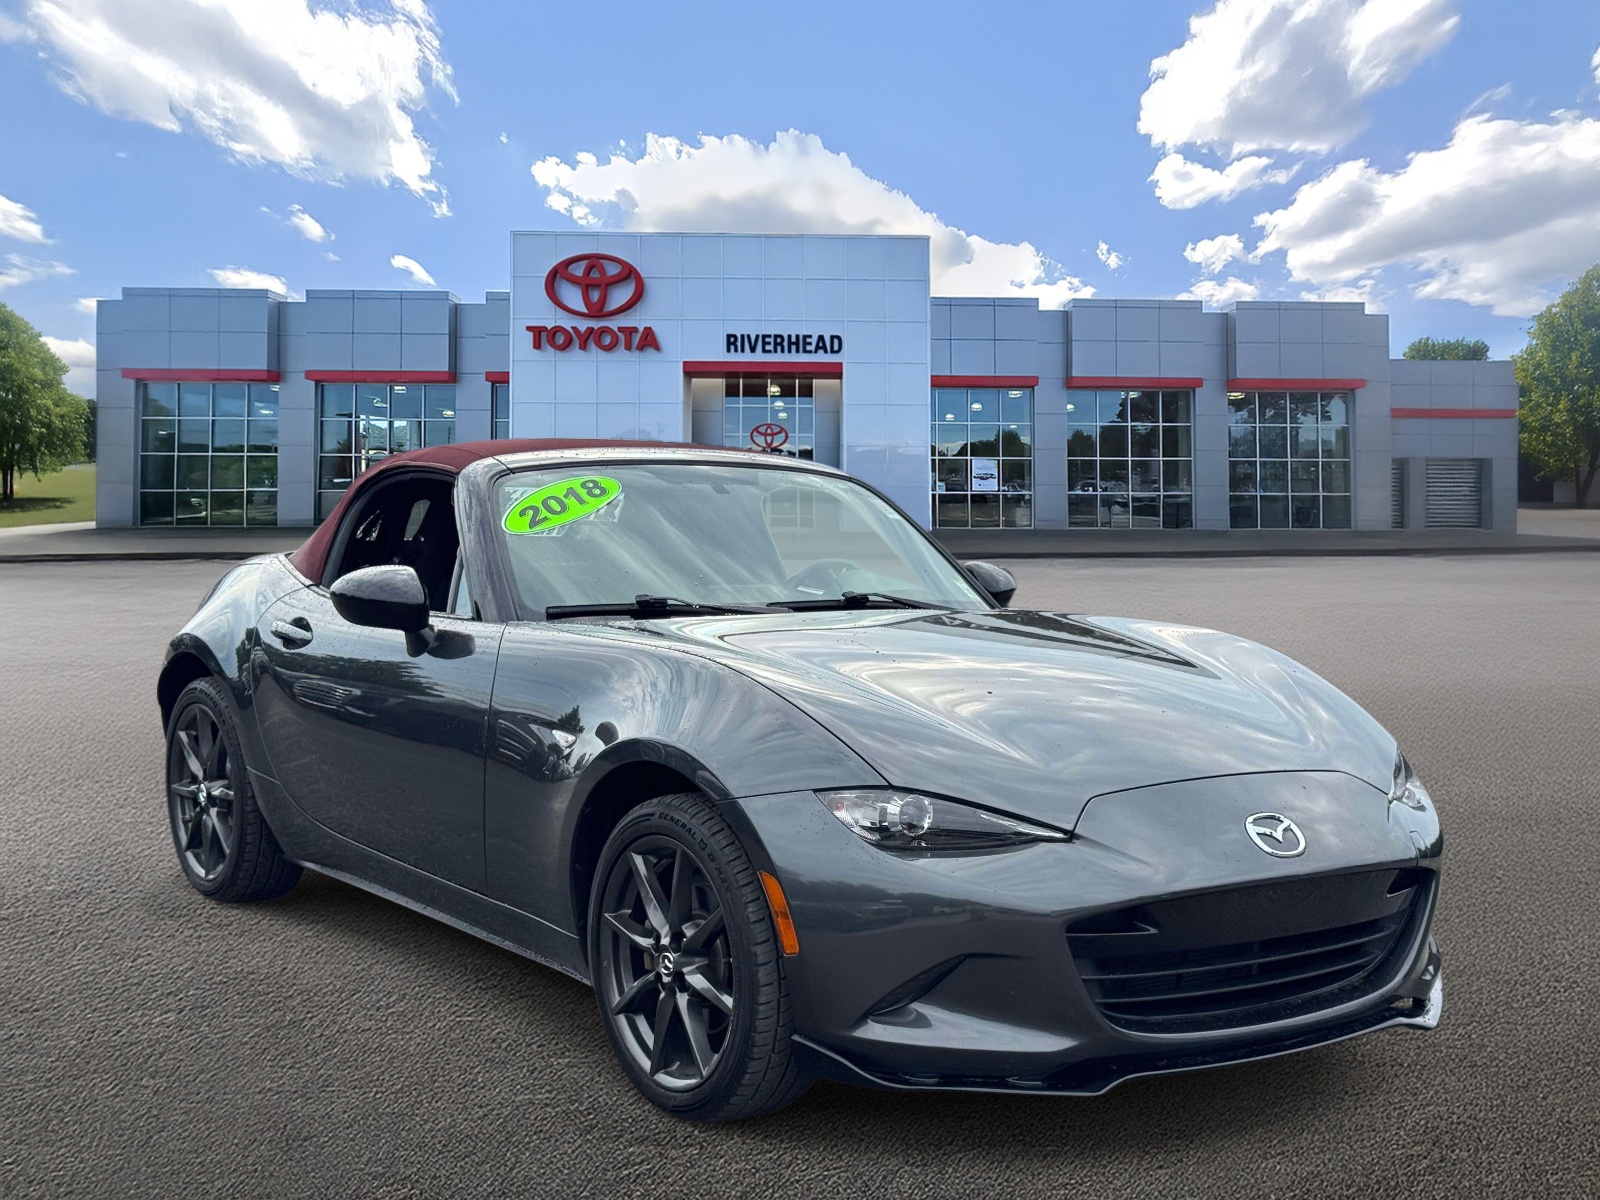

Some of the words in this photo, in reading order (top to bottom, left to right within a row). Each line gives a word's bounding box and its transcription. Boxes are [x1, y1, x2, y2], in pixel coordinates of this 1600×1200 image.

[525, 325, 661, 352] TOYOTA
[726, 333, 843, 354] RIVERHEAD
[518, 479, 609, 530] 2018
[657, 811, 697, 841] GENERAL
